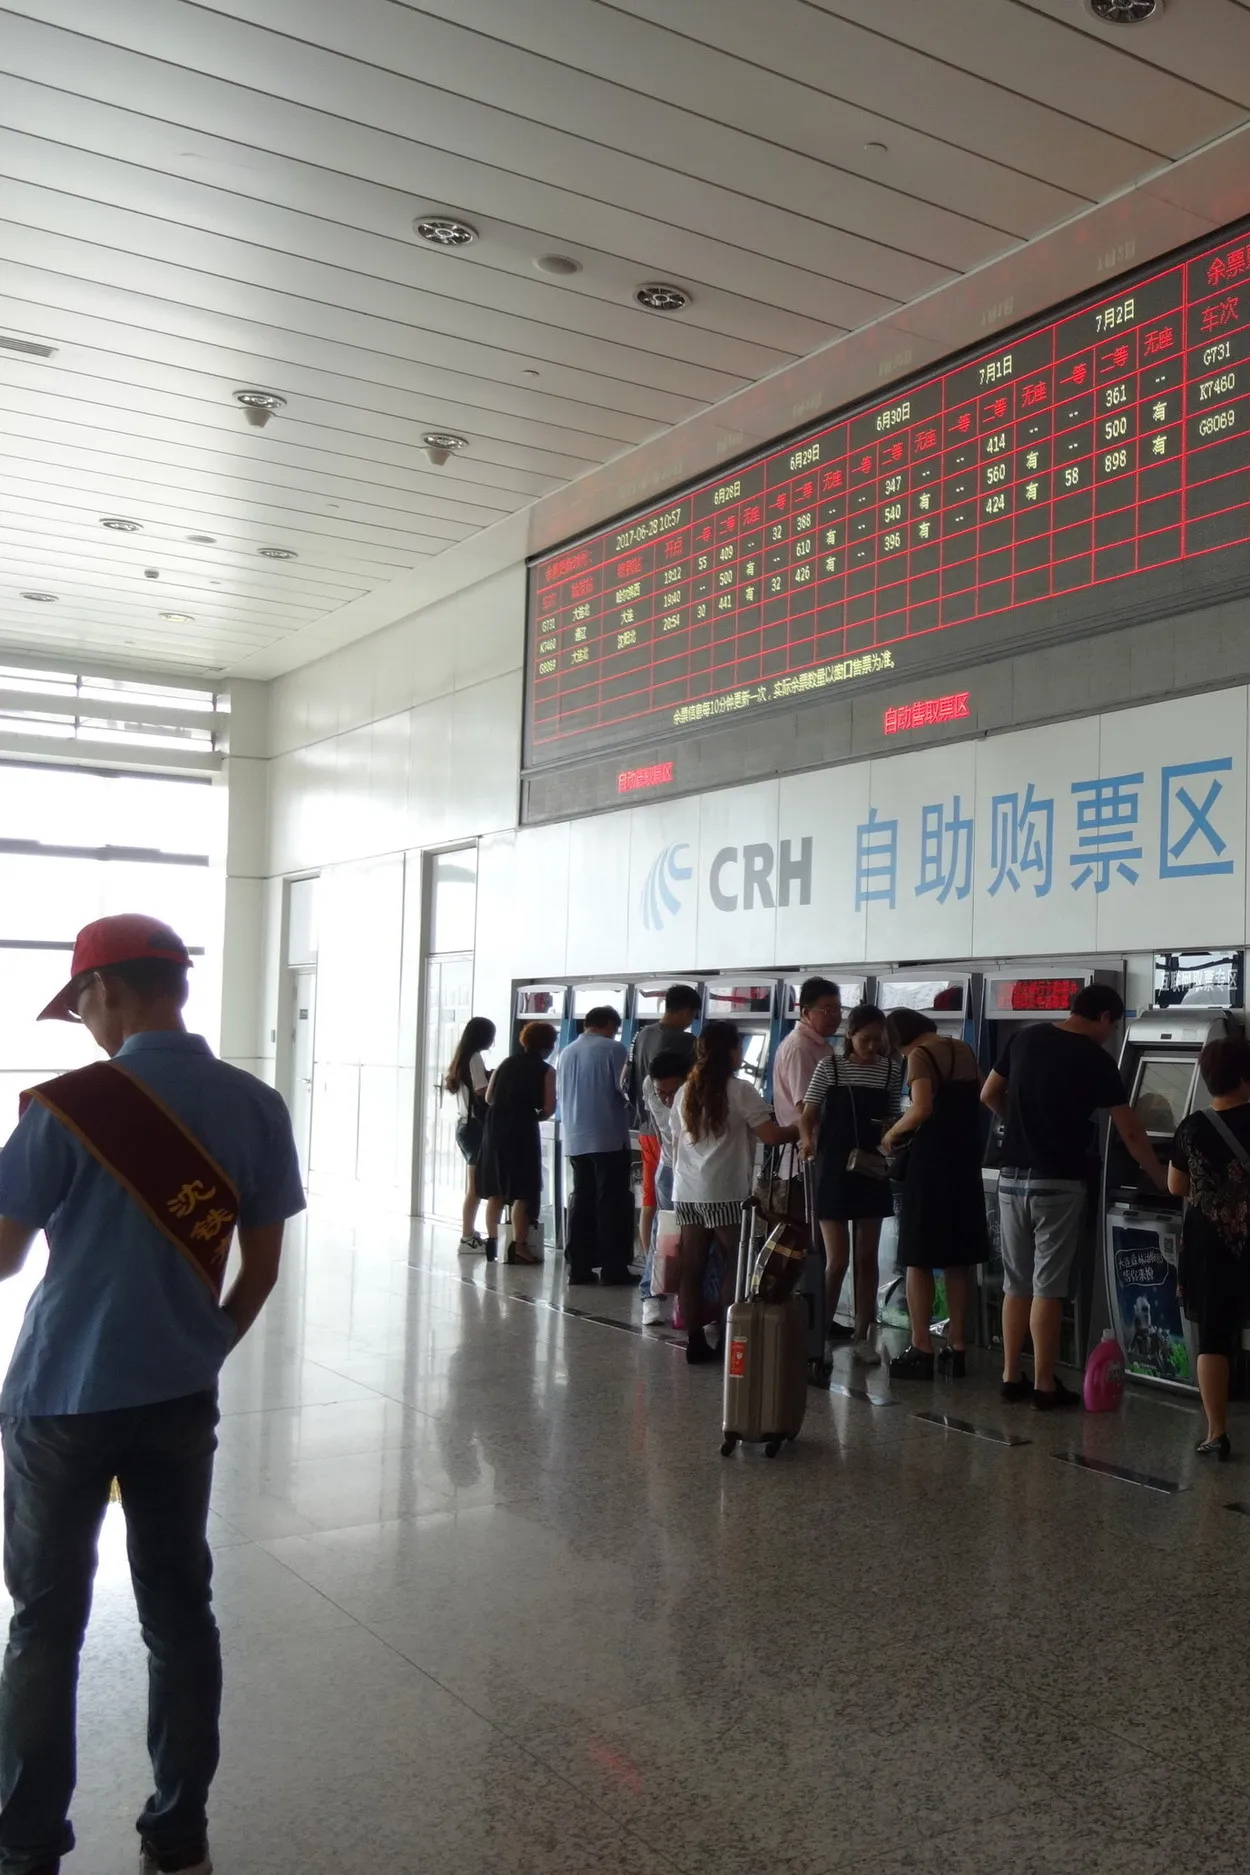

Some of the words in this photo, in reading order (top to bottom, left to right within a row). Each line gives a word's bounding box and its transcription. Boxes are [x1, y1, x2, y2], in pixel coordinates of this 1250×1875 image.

[1096, 299, 1135, 333] 7月2日
[1200, 295, 1239, 334] 车次
[1144, 327, 1173, 356] 无座
[1100, 345, 1129, 373] 二等
[1203, 340, 1231, 368] G731
[979, 355, 1013, 385] 7月1日
[1060, 363, 1087, 385] 一等
[1021, 381, 1047, 408] 无座
[1105, 385, 1127, 408] 361
[1199, 372, 1235, 402] K7460
[876, 402, 911, 432] 6月30日
[983, 397, 1008, 423] 二等
[1152, 402, 1167, 423] 有
[948, 413, 971, 433] 一等
[1105, 417, 1127, 439] 500
[1199, 410, 1235, 437] G8069
[914, 429, 937, 453] 无座
[986, 433, 1006, 453] 414
[1152, 435, 1167, 456] 有
[790, 444, 820, 471] 6月29日
[882, 442, 903, 466] 二等
[1026, 451, 1039, 470] 有
[1104, 450, 1127, 472] 898
[885, 476, 902, 495] 347
[986, 464, 1006, 484] 560
[1065, 467, 1079, 487] 58
[714, 481, 741, 505] 6月28日
[1025, 482, 1039, 501] 有
[885, 504, 901, 523] 540
[985, 494, 1005, 514] 424
[616, 519, 658, 551] 2017-06-28
[660, 508, 682, 530] 10:57
[772, 525, 782, 541] 32
[796, 540, 811, 557] 610
[884, 532, 901, 551] 396
[698, 555, 708, 571] 55
[771, 576, 782, 592] 32
[884, 691, 971, 735] 自动售取票区
[854, 756, 1235, 913] 自助购票区
[709, 836, 813, 912] CRH
[1159, 968, 1238, 994] 互联网取票专区
